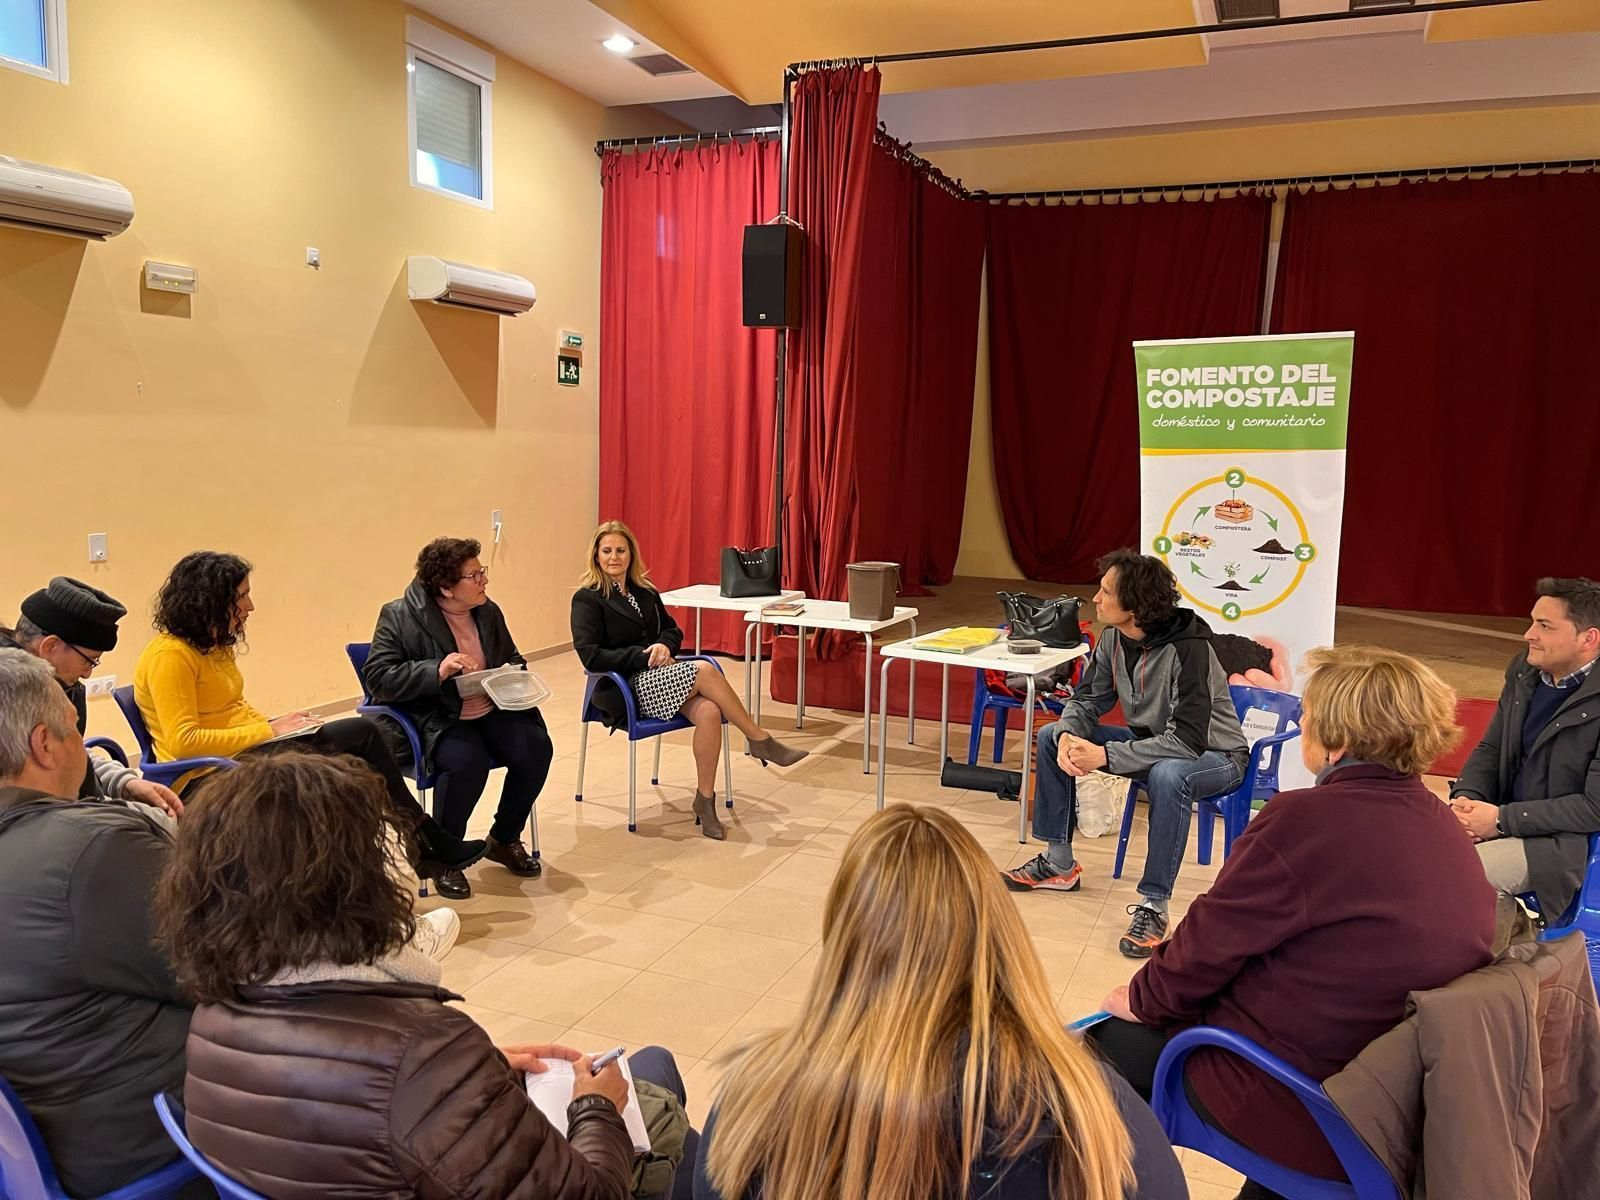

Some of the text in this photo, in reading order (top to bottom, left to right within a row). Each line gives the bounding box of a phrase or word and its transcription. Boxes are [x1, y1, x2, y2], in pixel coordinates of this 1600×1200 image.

[1146, 363, 1337, 387] FOMENTO DEL
[1146, 386, 1336, 409] COMPOSTAJE
[1152, 413, 1326, 431] doméstico y comunitario
[1229, 472, 1241, 485] 2
[1157, 540, 1166, 552] 1
[1298, 547, 1310, 558] 3
[1225, 605, 1237, 618] 4
